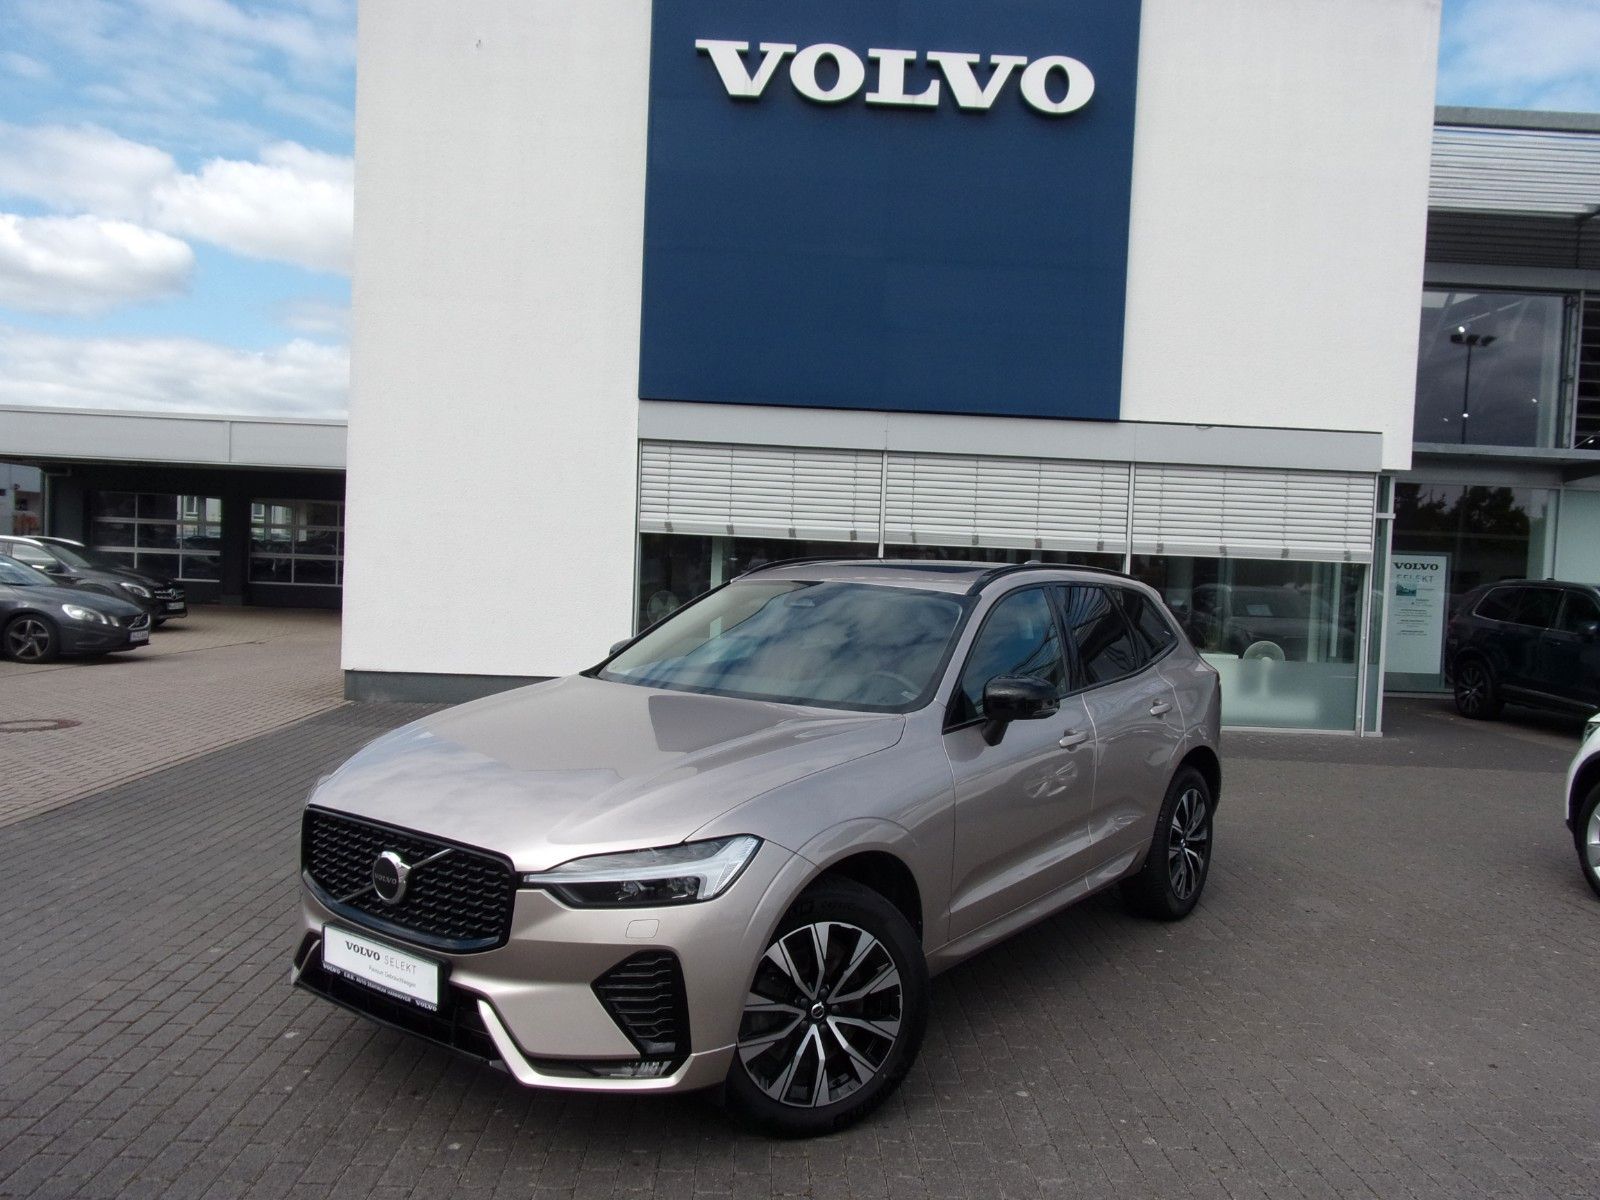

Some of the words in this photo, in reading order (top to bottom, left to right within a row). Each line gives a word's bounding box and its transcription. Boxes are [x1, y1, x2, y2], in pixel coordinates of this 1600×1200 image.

[695, 39, 1096, 115] VOLVO
[1393, 562, 1439, 571] VOLVO
[374, 872, 397, 885] VOLVO
[345, 940, 380, 961] VOLVO
[384, 955, 416, 974] SELEKT
[323, 962, 341, 975] VOLVO
[415, 998, 437, 1012] VOLVO
